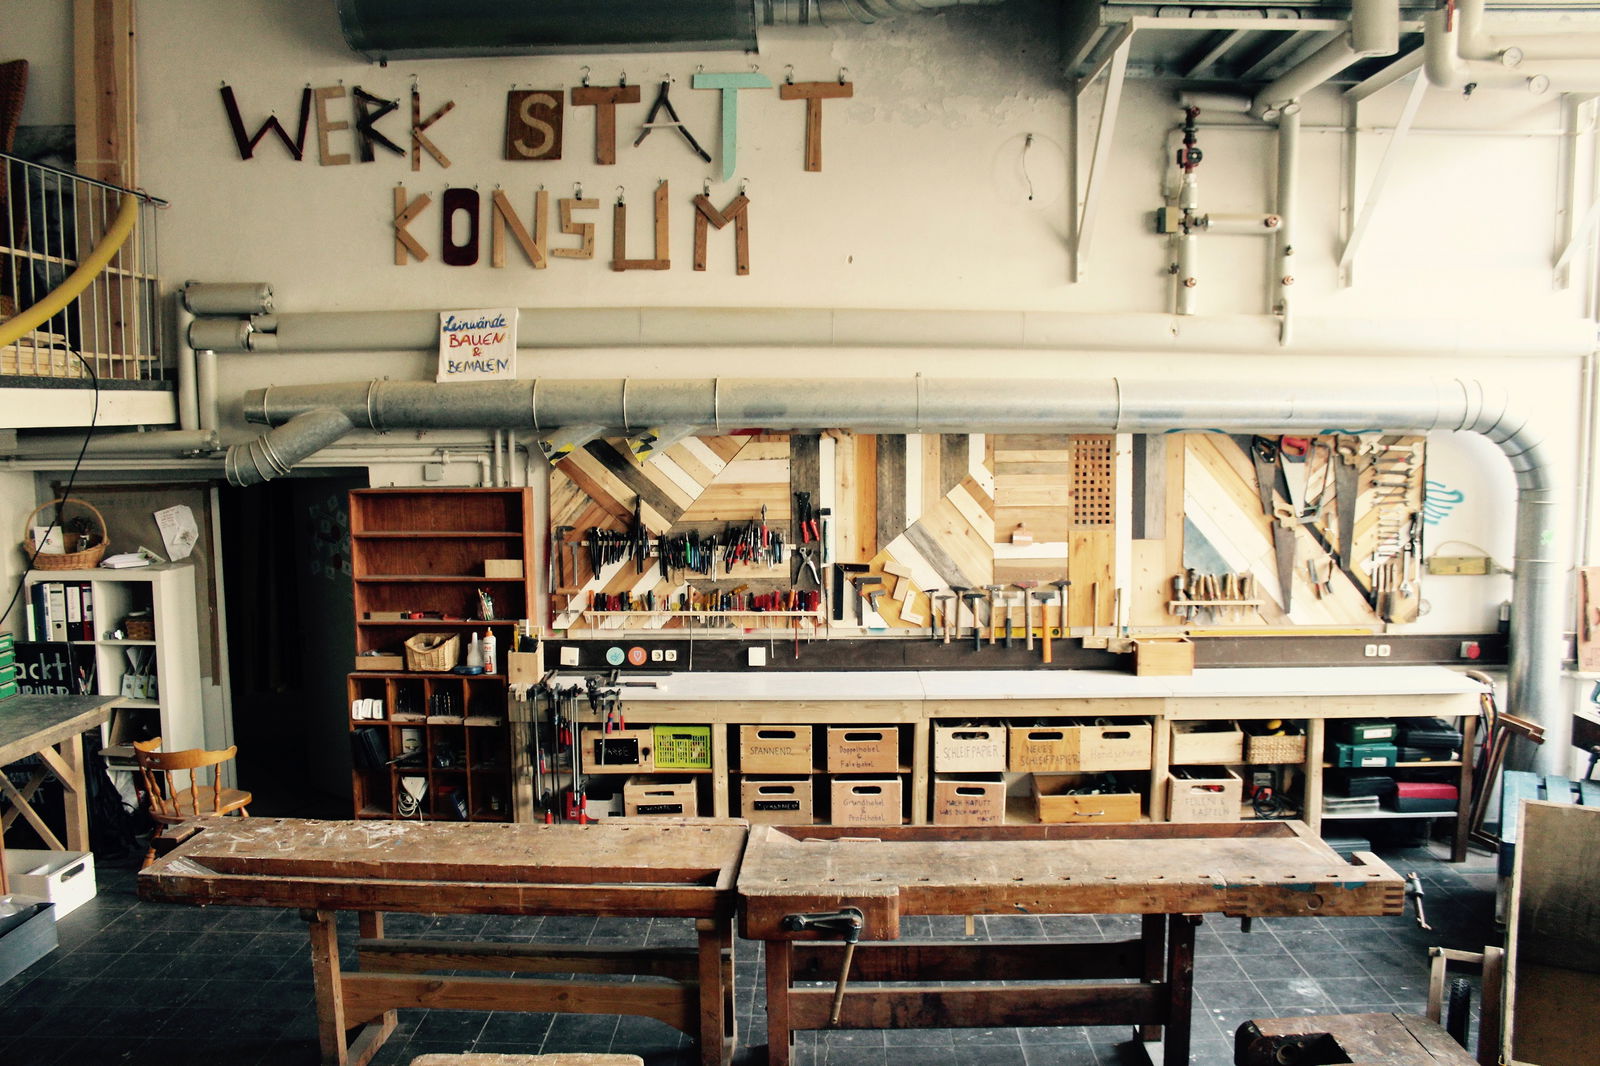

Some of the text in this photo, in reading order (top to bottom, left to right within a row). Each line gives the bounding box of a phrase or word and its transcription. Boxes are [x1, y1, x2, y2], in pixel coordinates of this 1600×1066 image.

[393, 179, 750, 275] KONSUM
[443, 314, 506, 332] Leinwände
[449, 332, 506, 348] BAUEN
[472, 346, 482, 356] &
[448, 359, 509, 373] BEMALEN
